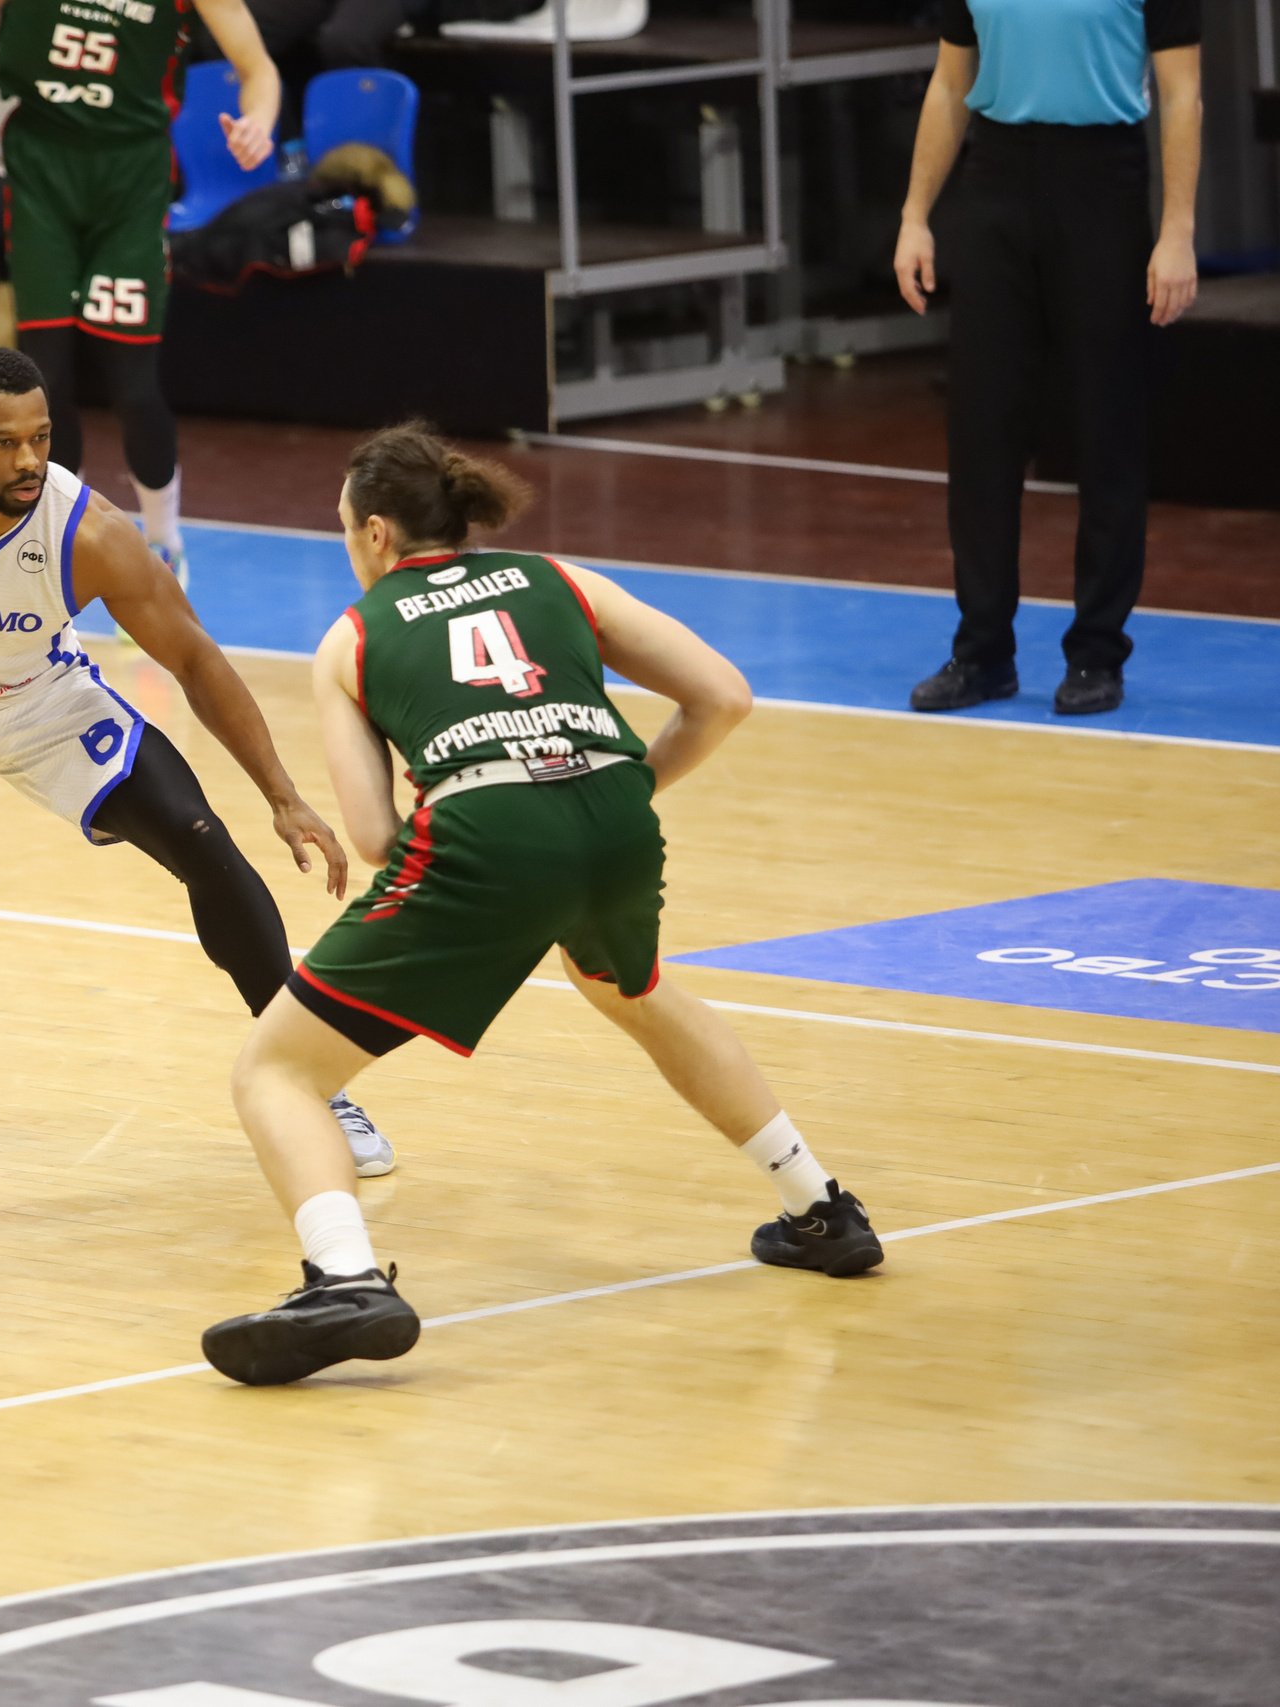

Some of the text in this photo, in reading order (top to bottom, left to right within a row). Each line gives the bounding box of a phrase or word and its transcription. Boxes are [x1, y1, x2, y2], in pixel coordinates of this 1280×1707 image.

[48, 23, 118, 75] 55
[82, 274, 149, 326] 55
[21, 551, 44, 564] РФБ
[394, 567, 531, 622] ВЕДИЩЕВ
[448, 609, 548, 698] 4
[79, 717, 124, 766] 6
